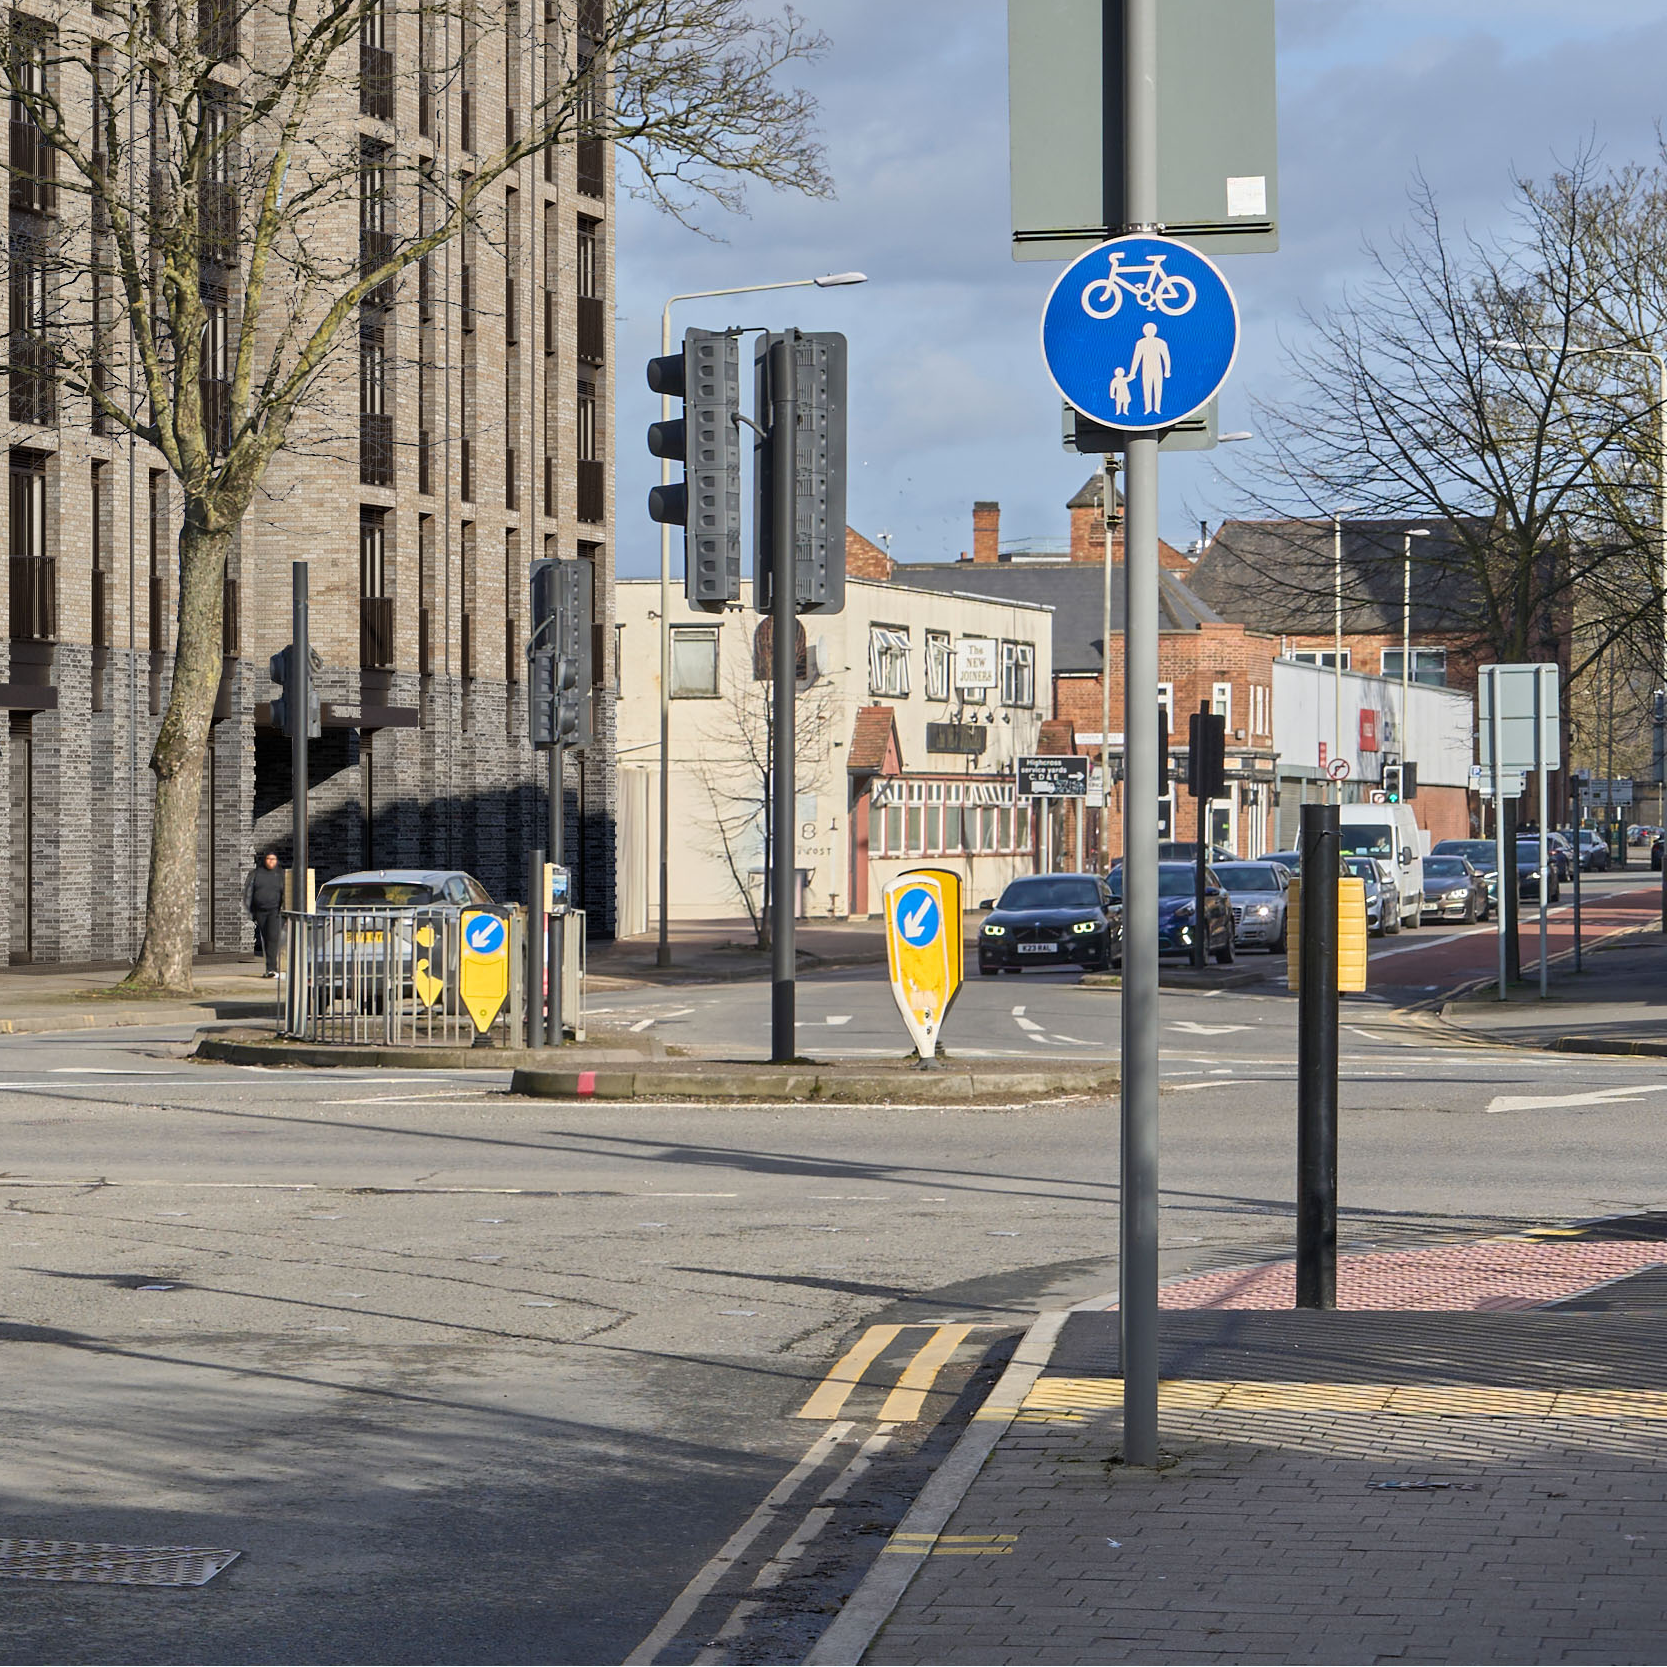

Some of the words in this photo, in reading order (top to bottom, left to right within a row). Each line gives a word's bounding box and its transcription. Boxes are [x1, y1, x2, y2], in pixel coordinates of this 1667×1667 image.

[969, 645, 984, 654] The
[966, 657, 987, 668] NEW
[1027, 759, 1062, 769] Highcross
[1048, 766, 1067, 774] yards
